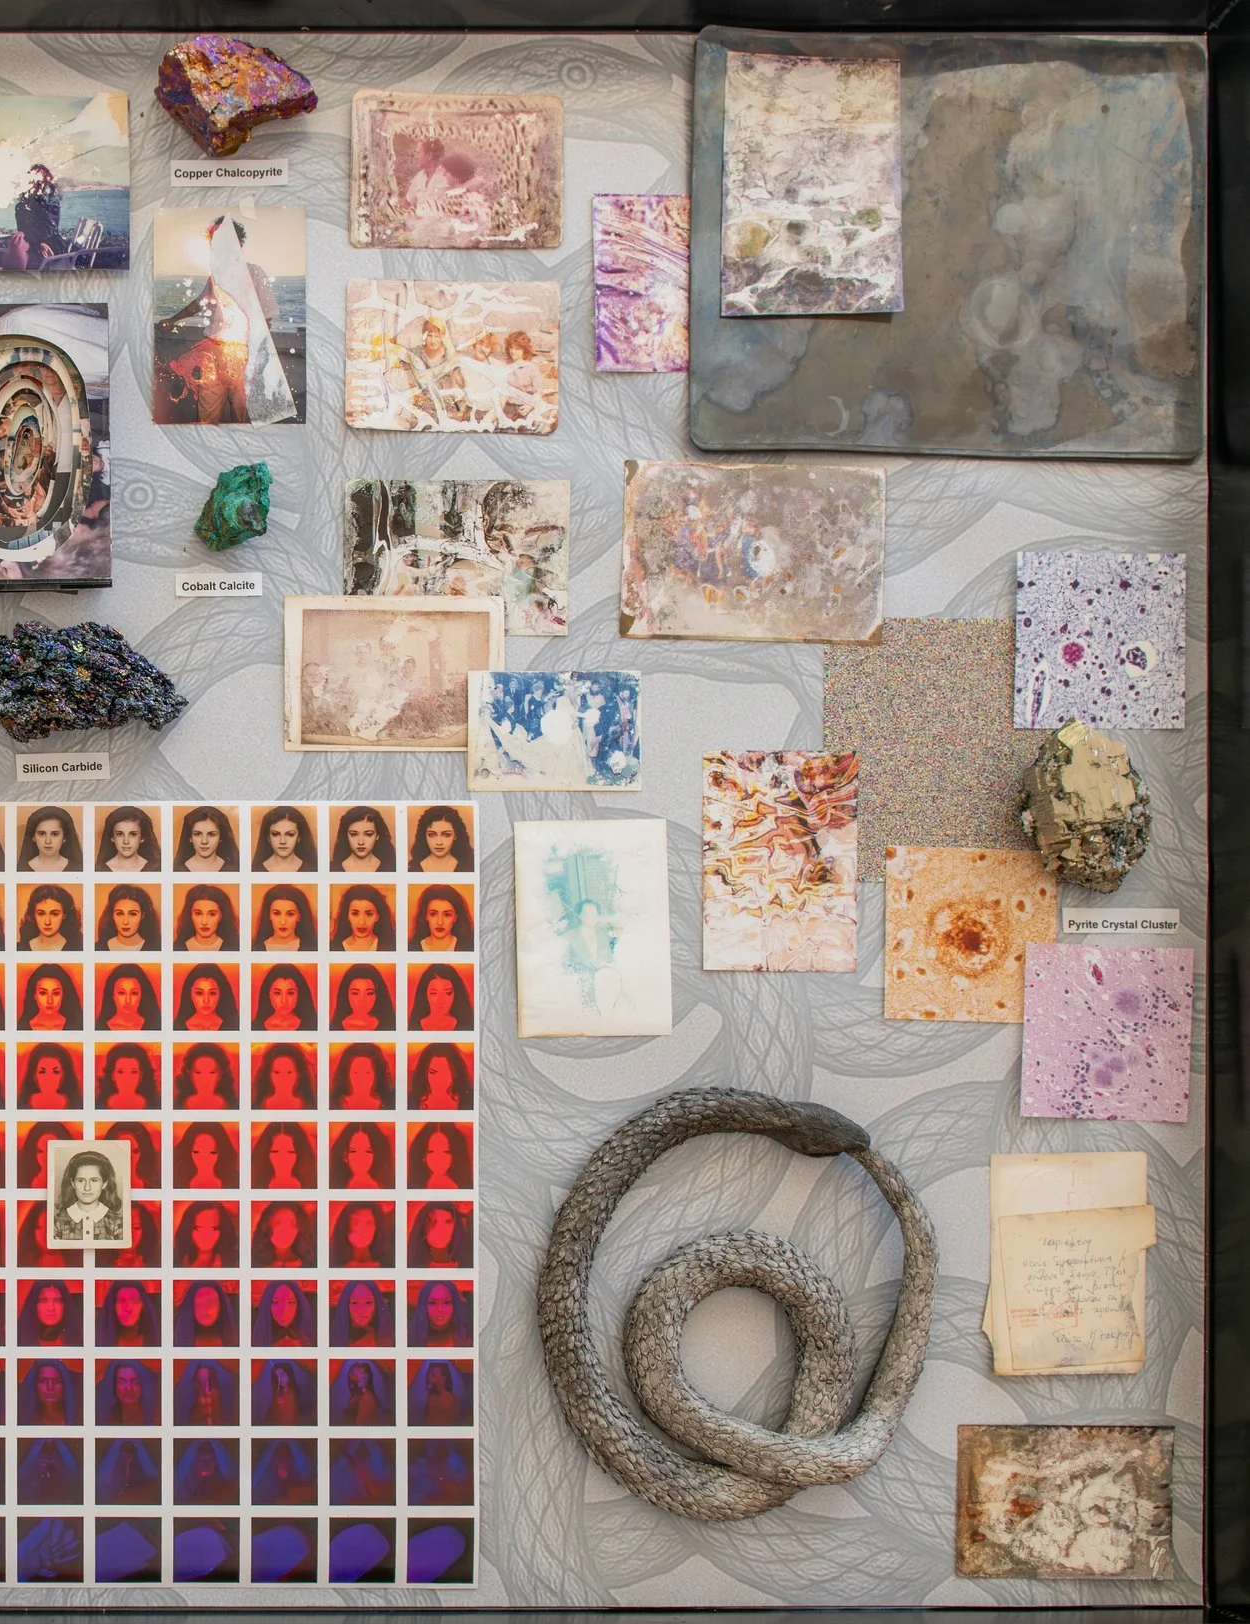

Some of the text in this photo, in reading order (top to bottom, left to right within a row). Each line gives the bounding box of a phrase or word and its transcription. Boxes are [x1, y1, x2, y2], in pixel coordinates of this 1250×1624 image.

[174, 167, 282, 180] Copper Chalcopyrite
[182, 581, 255, 591] Cobalt Calcite
[23, 762, 102, 774] Silicon Carbide
[1068, 920, 1178, 931] Pyrite Crystal Cluster
